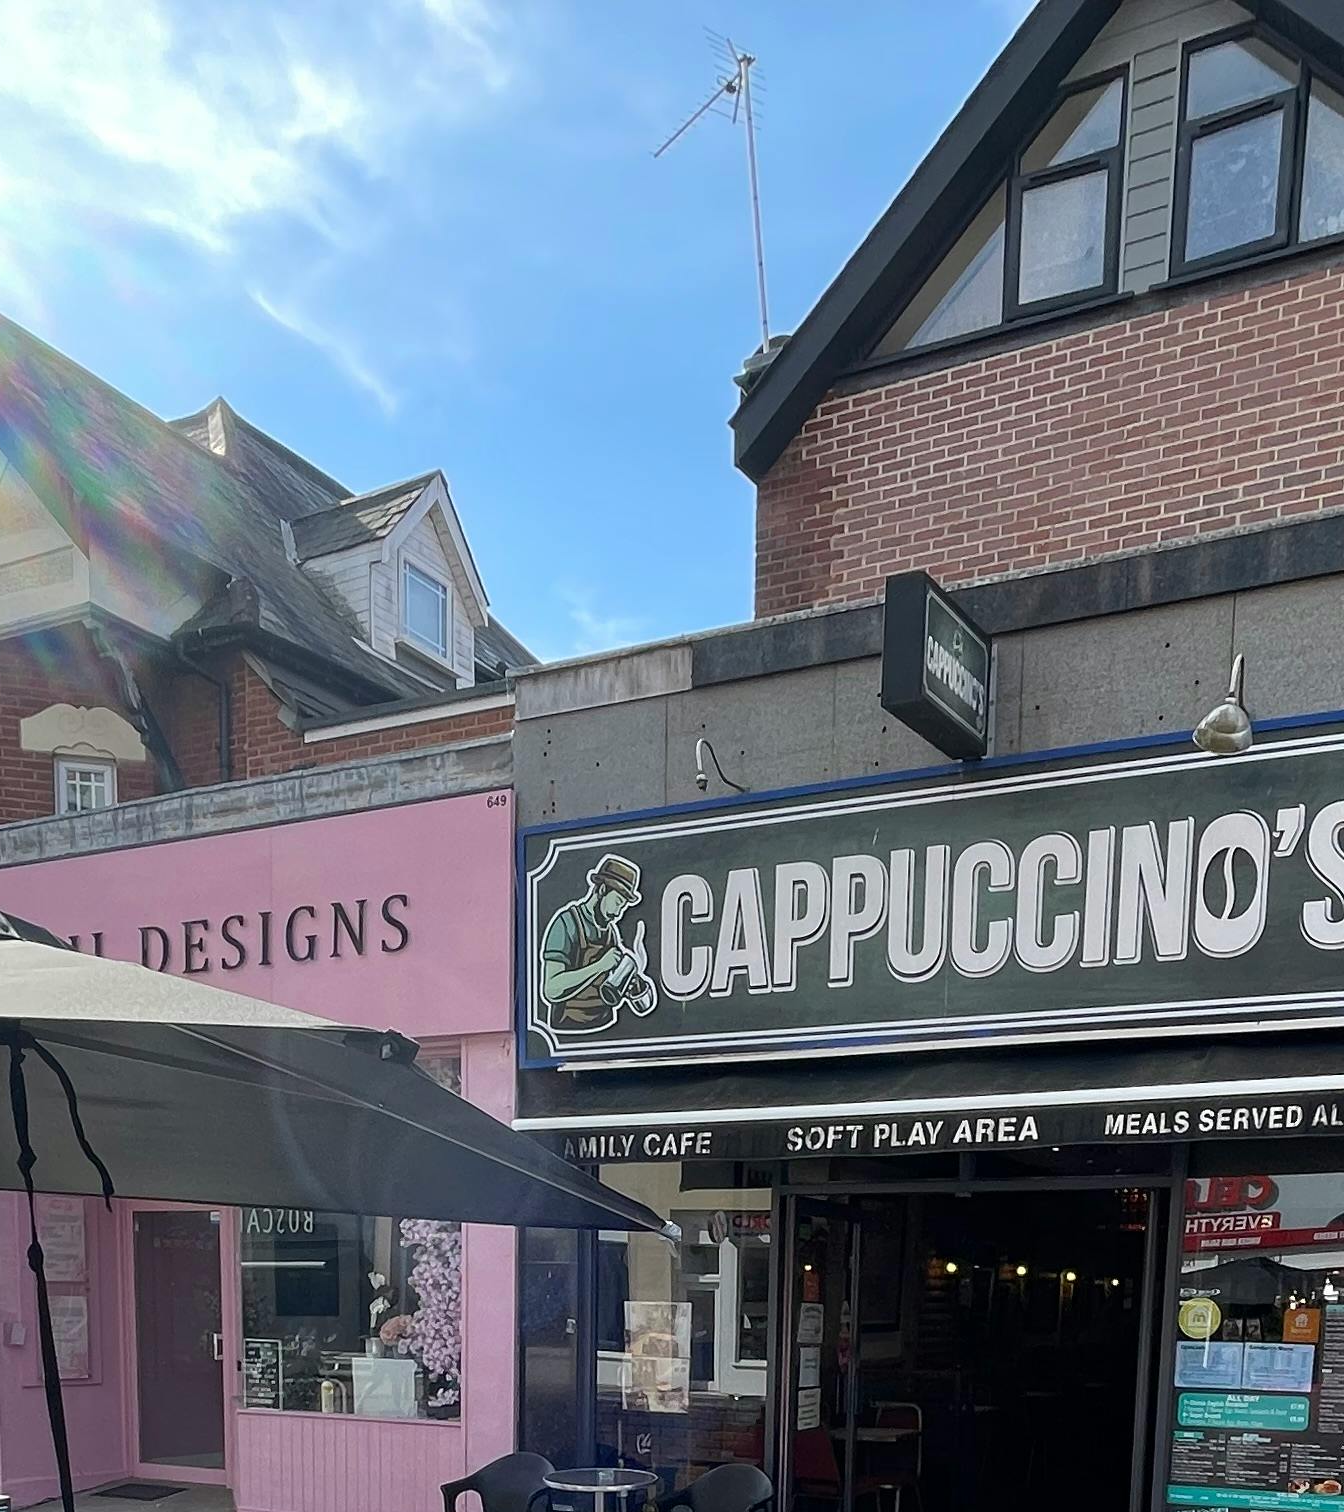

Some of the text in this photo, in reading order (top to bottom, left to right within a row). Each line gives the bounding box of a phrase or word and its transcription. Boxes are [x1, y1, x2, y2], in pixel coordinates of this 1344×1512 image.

[486, 795, 507, 809] 649
[138, 894, 410, 973] DESIGNS
[787, 1116, 1040, 1153] SOFT PLAY AREA
[1104, 1111, 1190, 1136] MEALS
[1198, 1105, 1303, 1132] SERVED
[643, 1132, 712, 1156] CAFE
